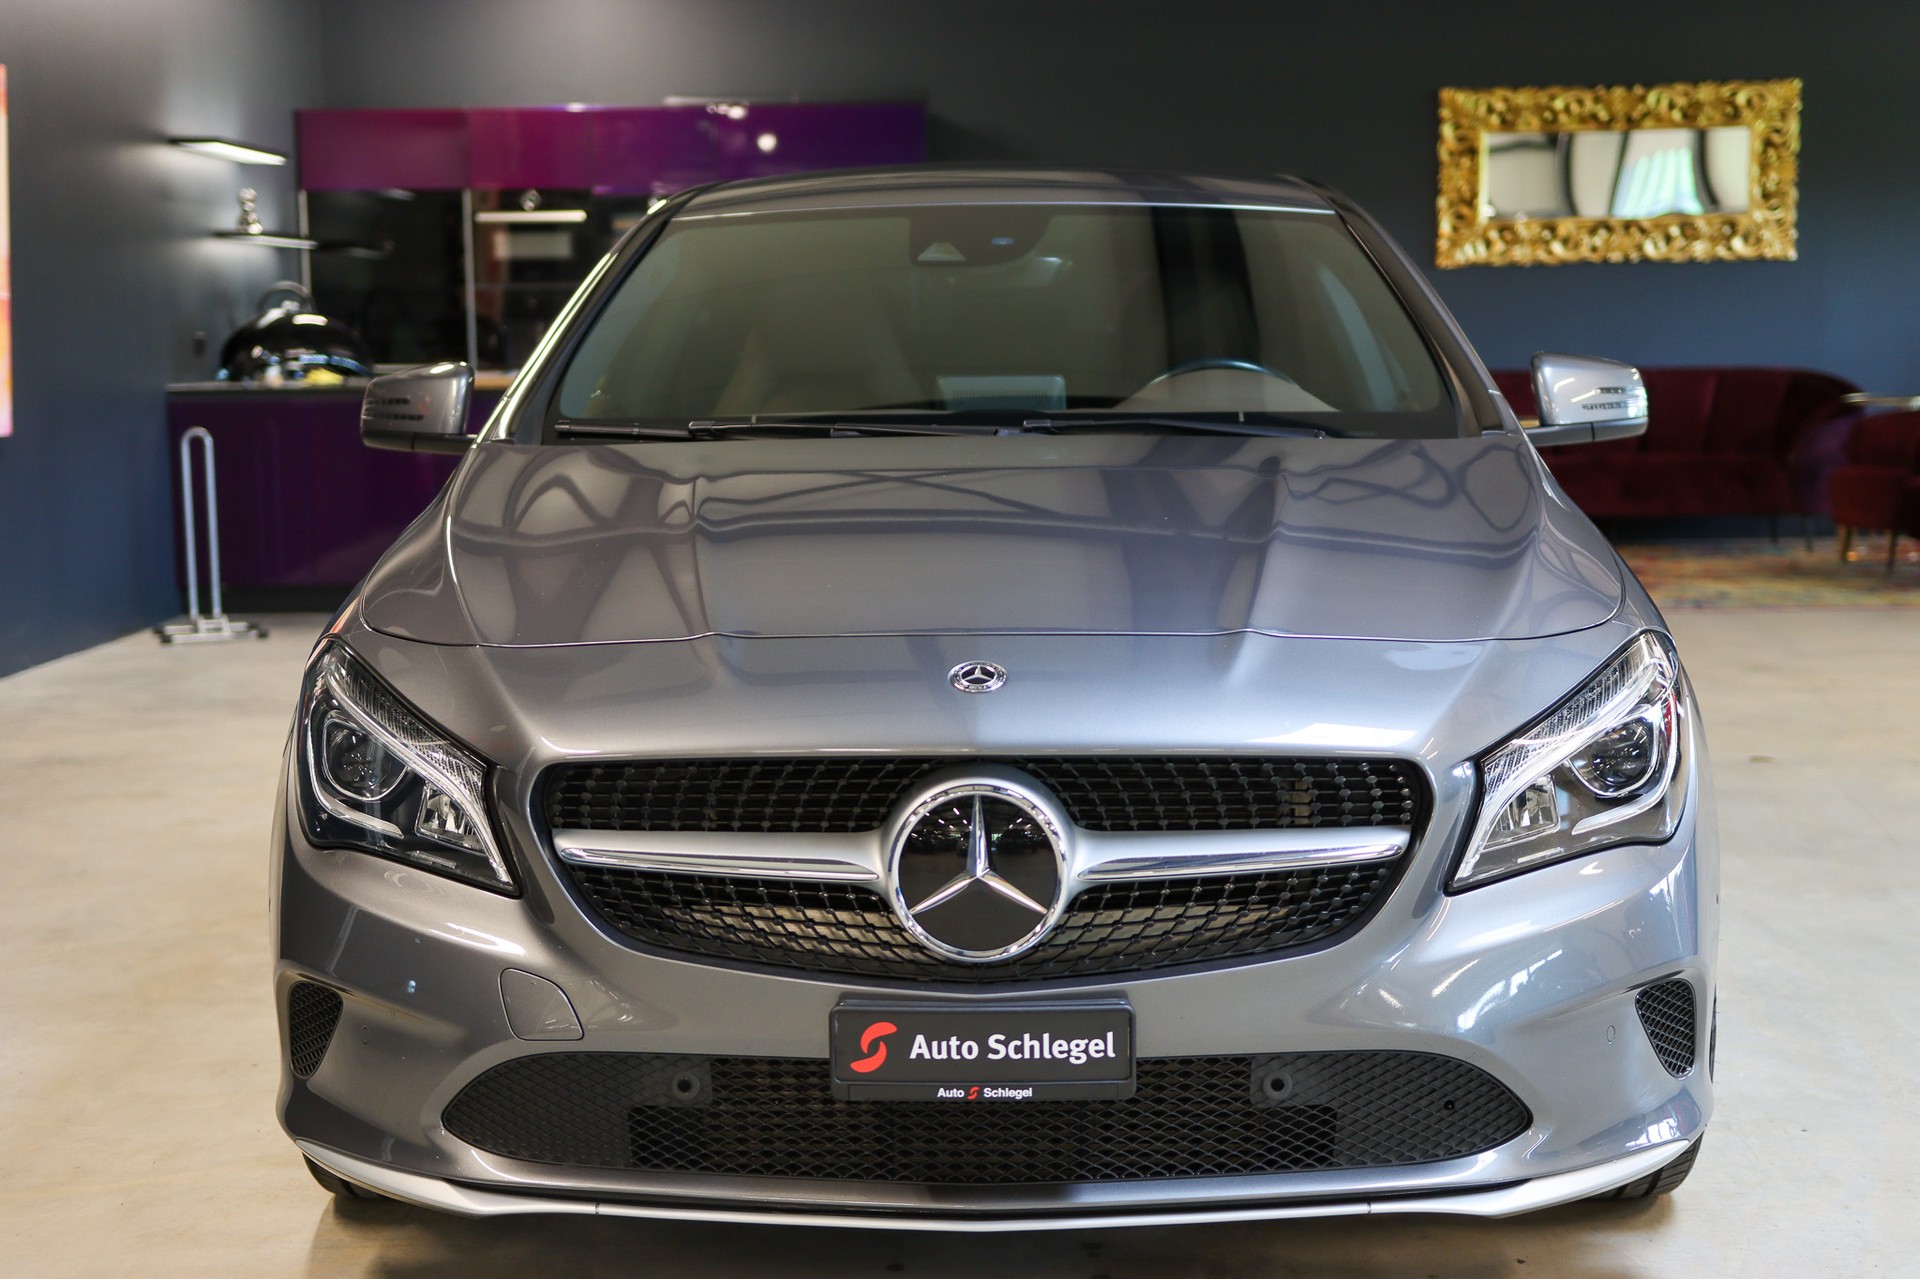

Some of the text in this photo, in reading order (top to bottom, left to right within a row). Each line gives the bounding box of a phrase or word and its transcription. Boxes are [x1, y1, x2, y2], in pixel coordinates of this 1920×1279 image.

[909, 1032, 1116, 1065] Auto Schlegel
[937, 1087, 1033, 1101] Auto Schlegel
